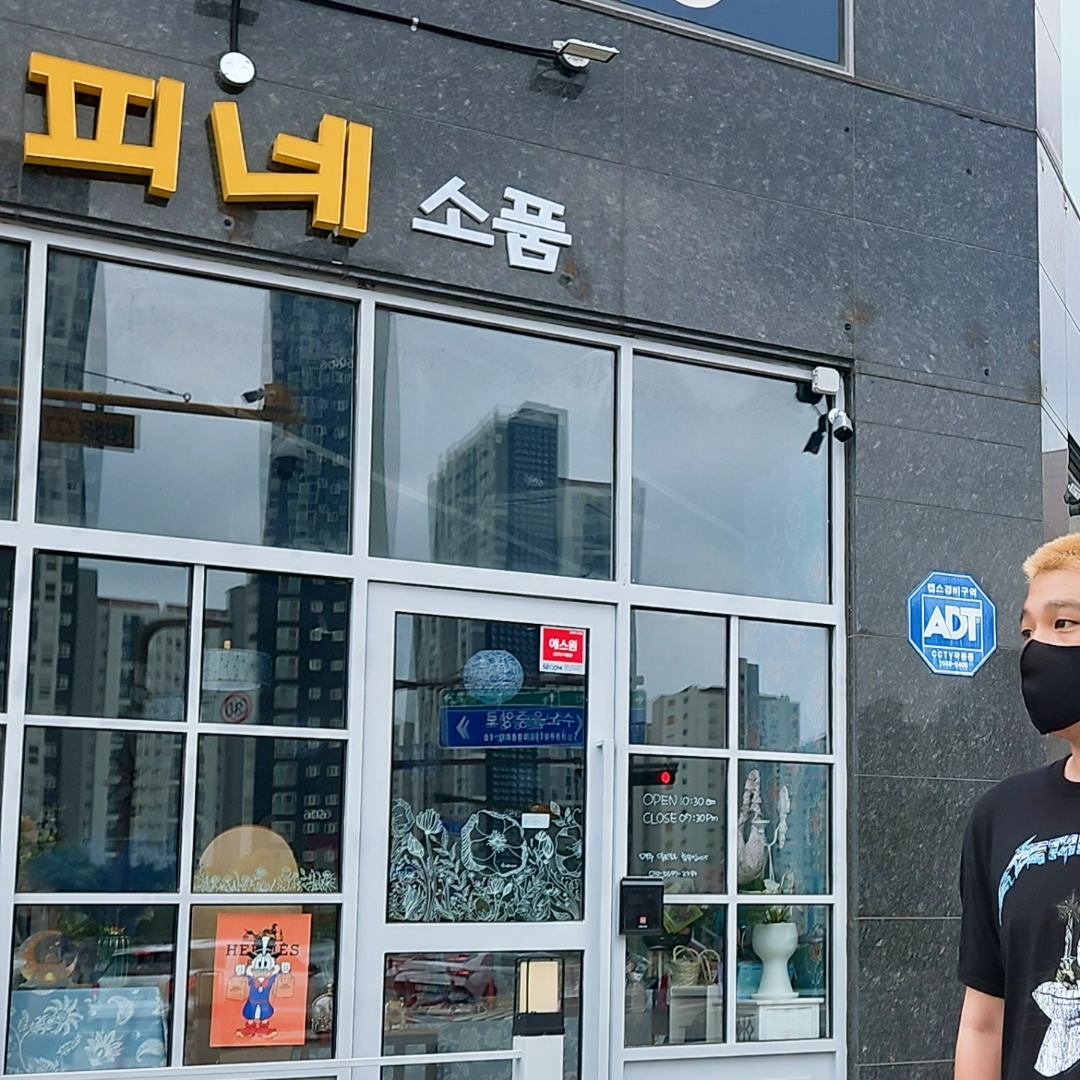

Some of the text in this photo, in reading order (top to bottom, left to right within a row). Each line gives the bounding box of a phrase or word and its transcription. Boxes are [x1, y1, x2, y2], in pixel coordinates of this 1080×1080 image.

[23, 51, 374, 239] 피네
[411, 175, 573, 274] 소품
[924, 605, 981, 642] ADT
[548, 638, 578, 652] 에스원
[642, 793, 678, 806] OPEN
[642, 812, 678, 825] CLOSE
